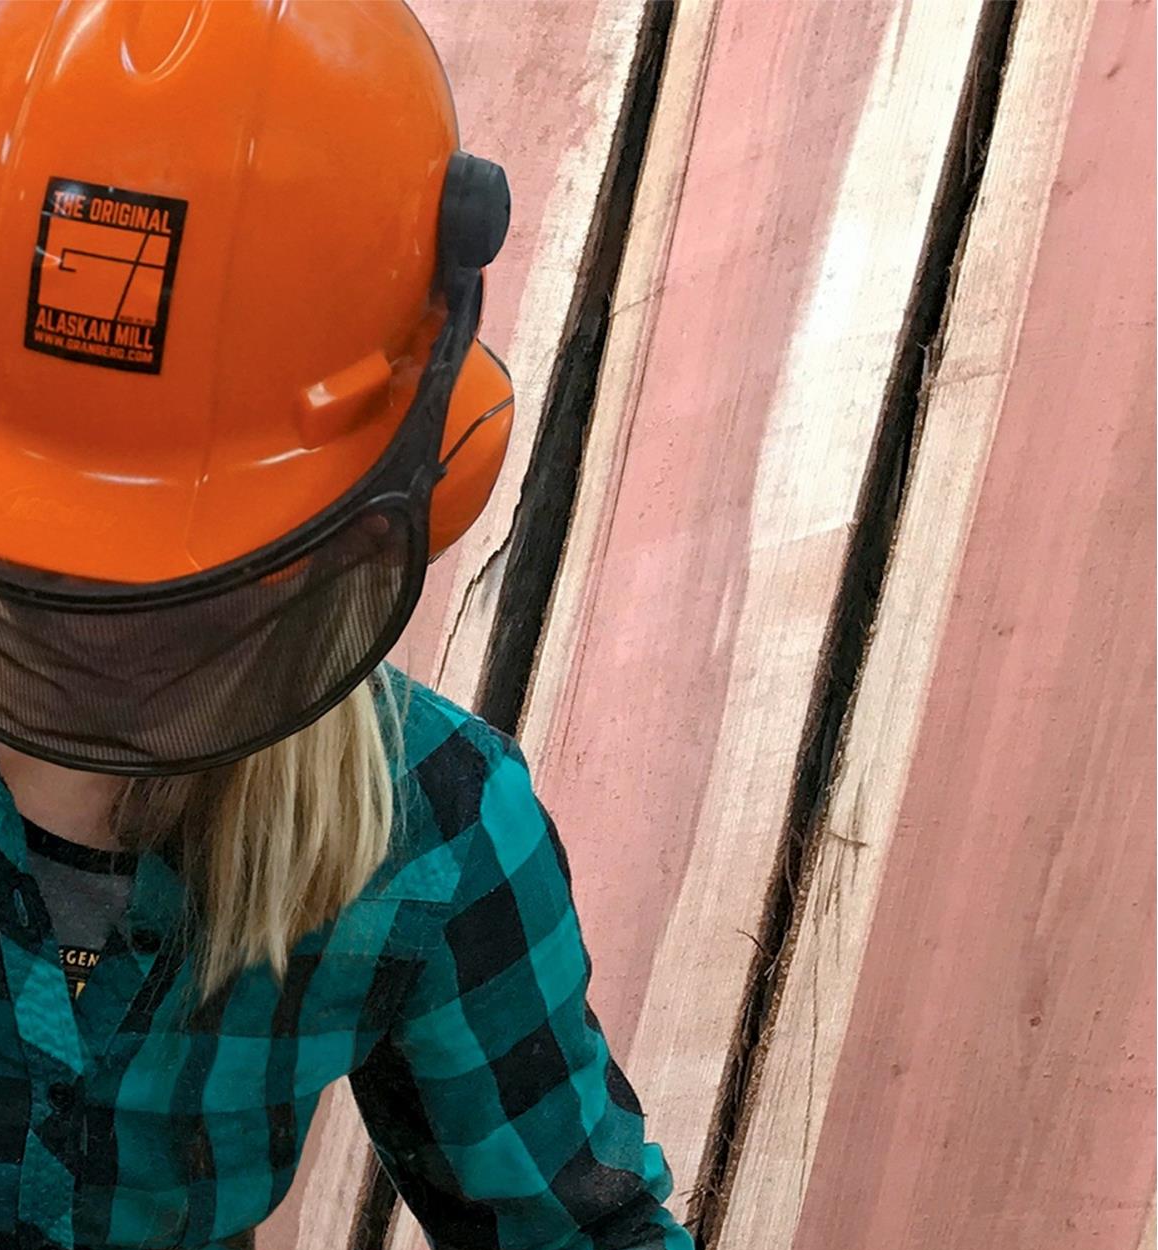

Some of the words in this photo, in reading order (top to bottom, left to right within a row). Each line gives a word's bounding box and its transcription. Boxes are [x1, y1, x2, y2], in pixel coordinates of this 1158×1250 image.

[52, 191, 86, 219] THE
[90, 197, 172, 234] ORIGINAL
[35, 308, 111, 343] ALASKAN
[114, 324, 153, 350] MILL
